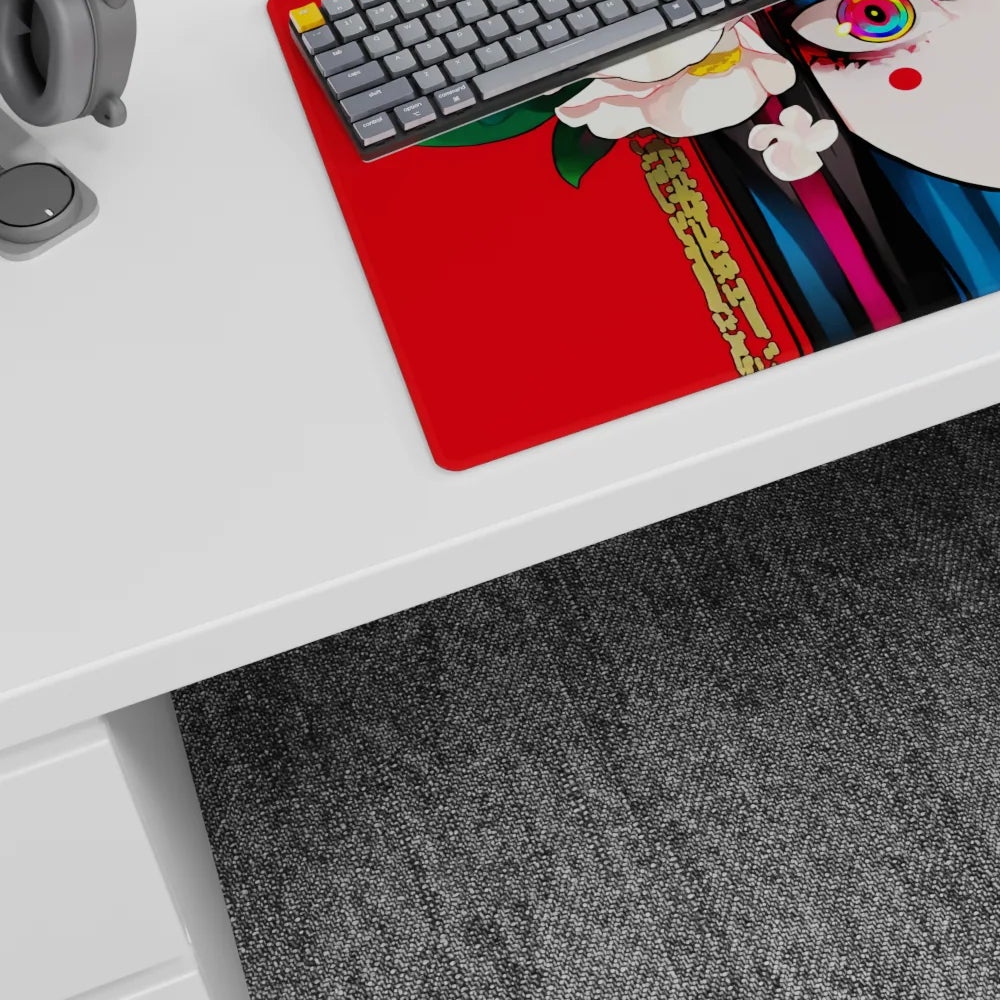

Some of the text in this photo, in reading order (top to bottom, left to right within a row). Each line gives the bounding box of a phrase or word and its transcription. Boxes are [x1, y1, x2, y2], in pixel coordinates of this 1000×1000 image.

[438, 85, 466, 99] command
[403, 102, 423, 113] option
[362, 117, 383, 128] control
